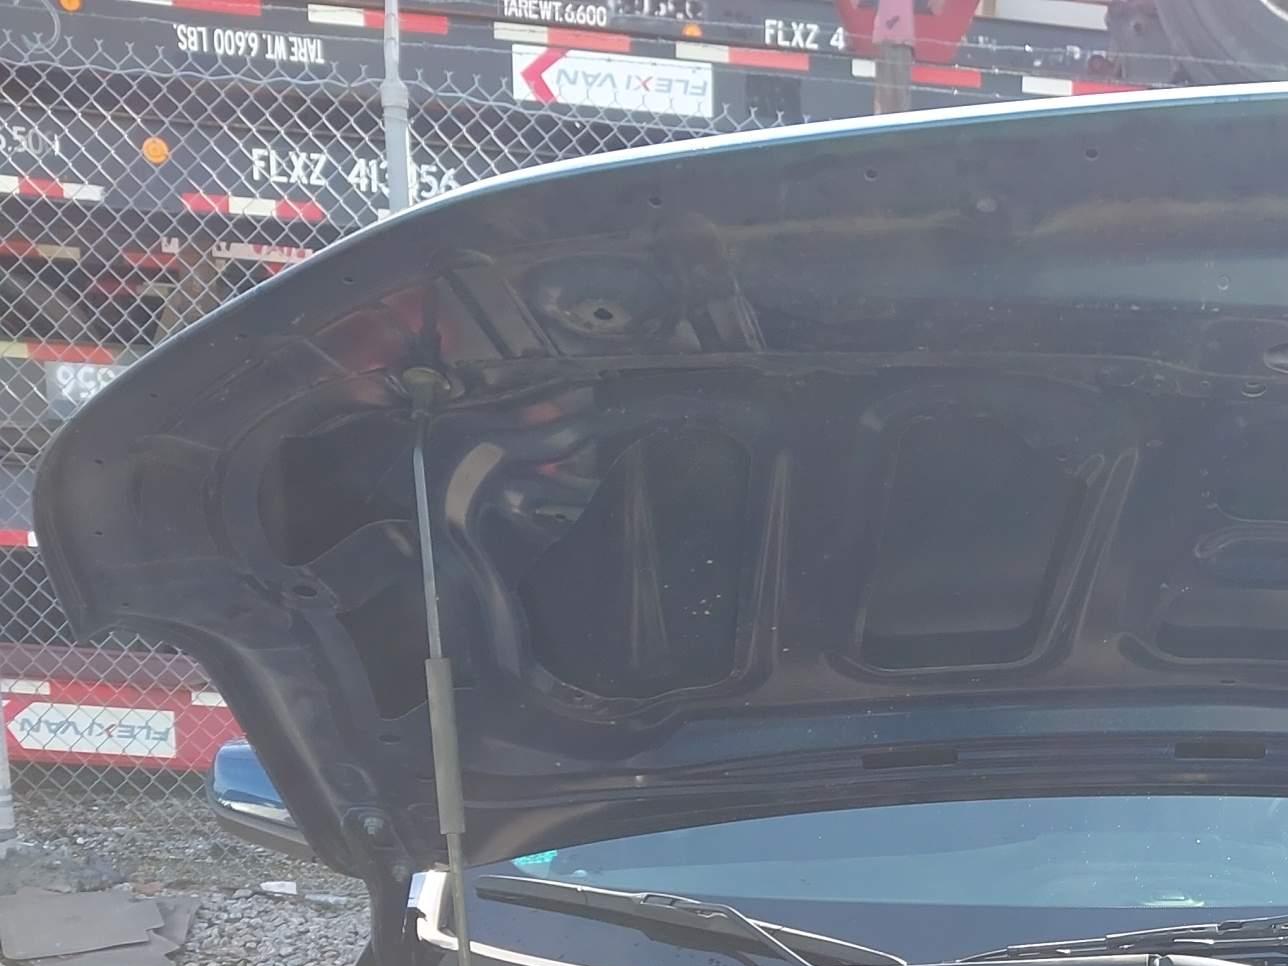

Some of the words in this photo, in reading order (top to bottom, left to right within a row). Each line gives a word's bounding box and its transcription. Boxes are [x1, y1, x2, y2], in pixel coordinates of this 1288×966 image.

[173, 23, 207, 53] LBS.
[262, 33, 287, 61] WT.
[764, 18, 820, 49] FLXZ
[288, 36, 325, 64] TARE
[251, 148, 328, 186] FLXZ
